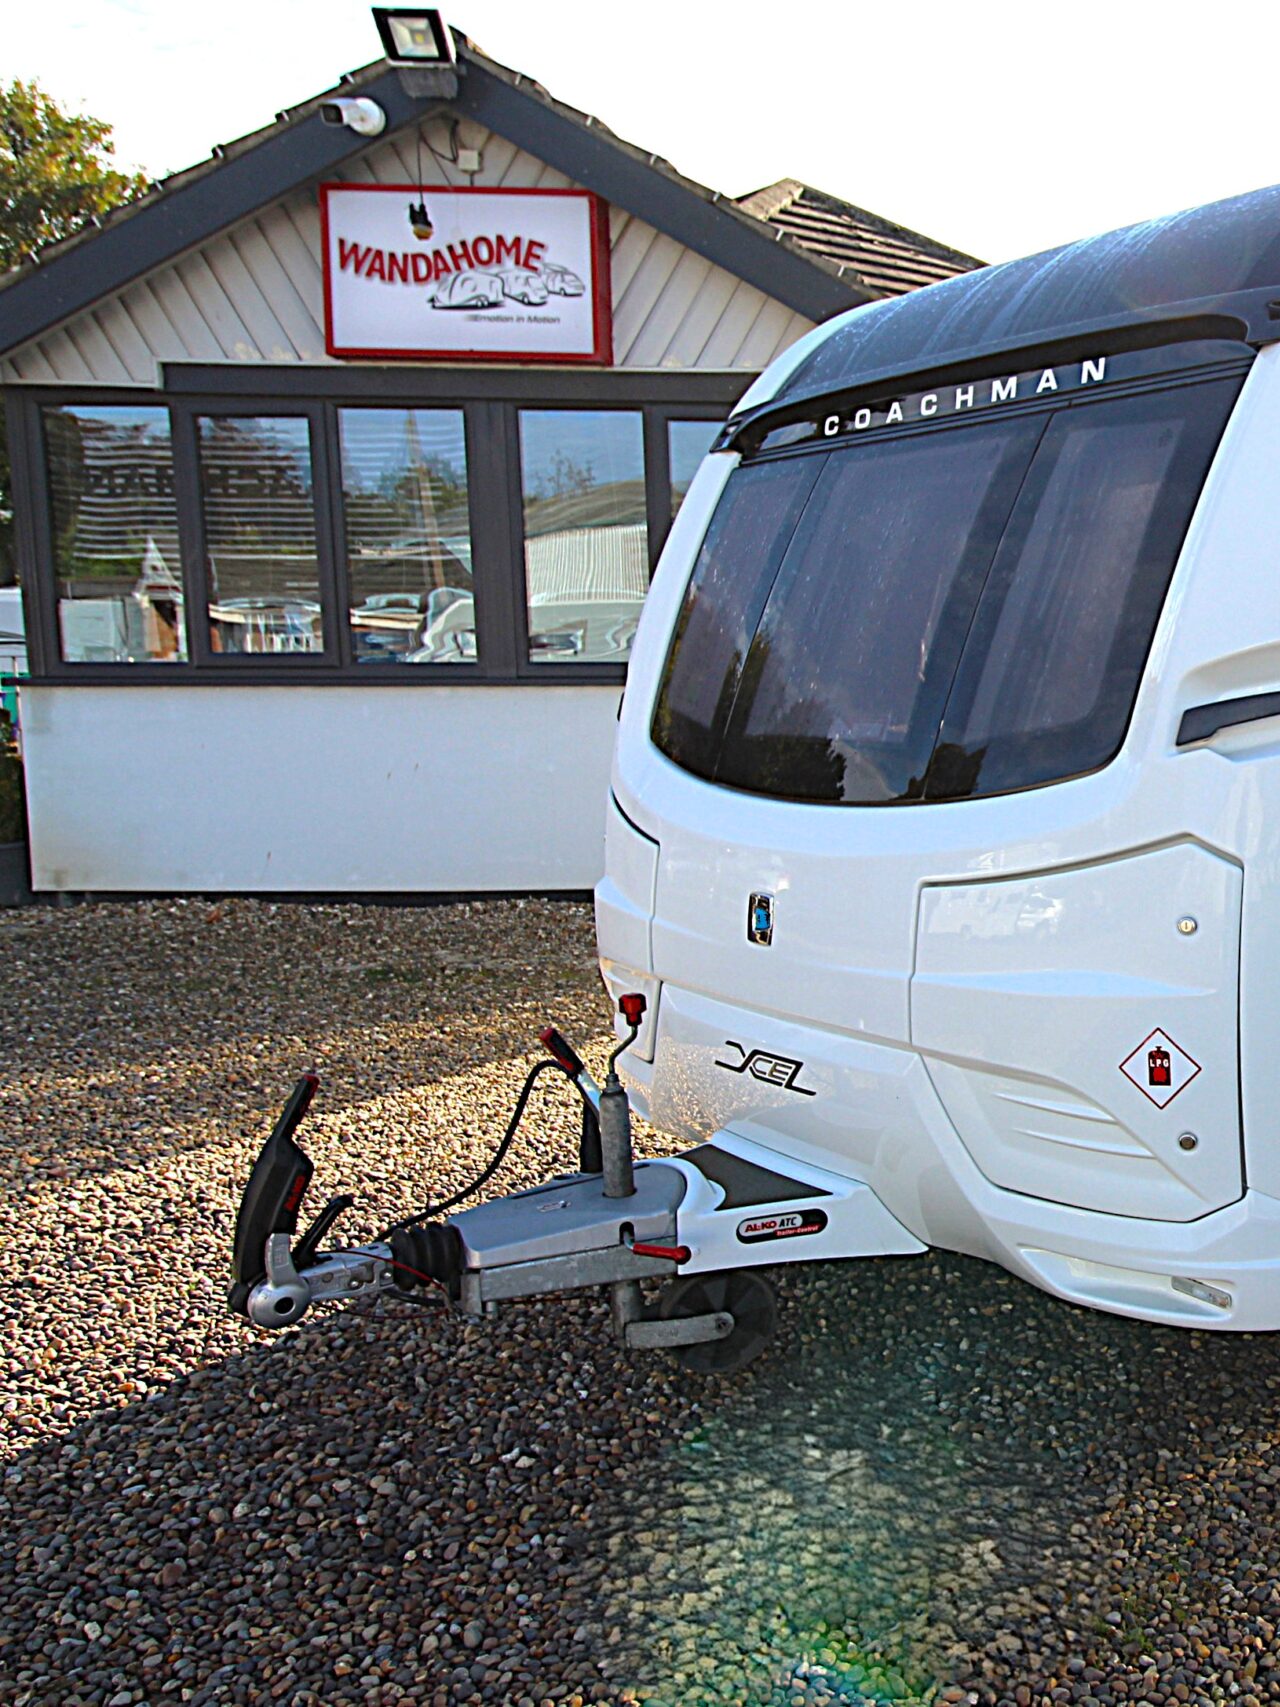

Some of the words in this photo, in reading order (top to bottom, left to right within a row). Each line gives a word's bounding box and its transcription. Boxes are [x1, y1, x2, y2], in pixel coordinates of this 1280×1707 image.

[337, 234, 545, 283] WANDAHOME
[527, 316, 560, 324] Motion
[824, 357, 1107, 436] COACHMAN
[1149, 1058, 1169, 1068] LPG
[778, 1216, 798, 1228] ATC
